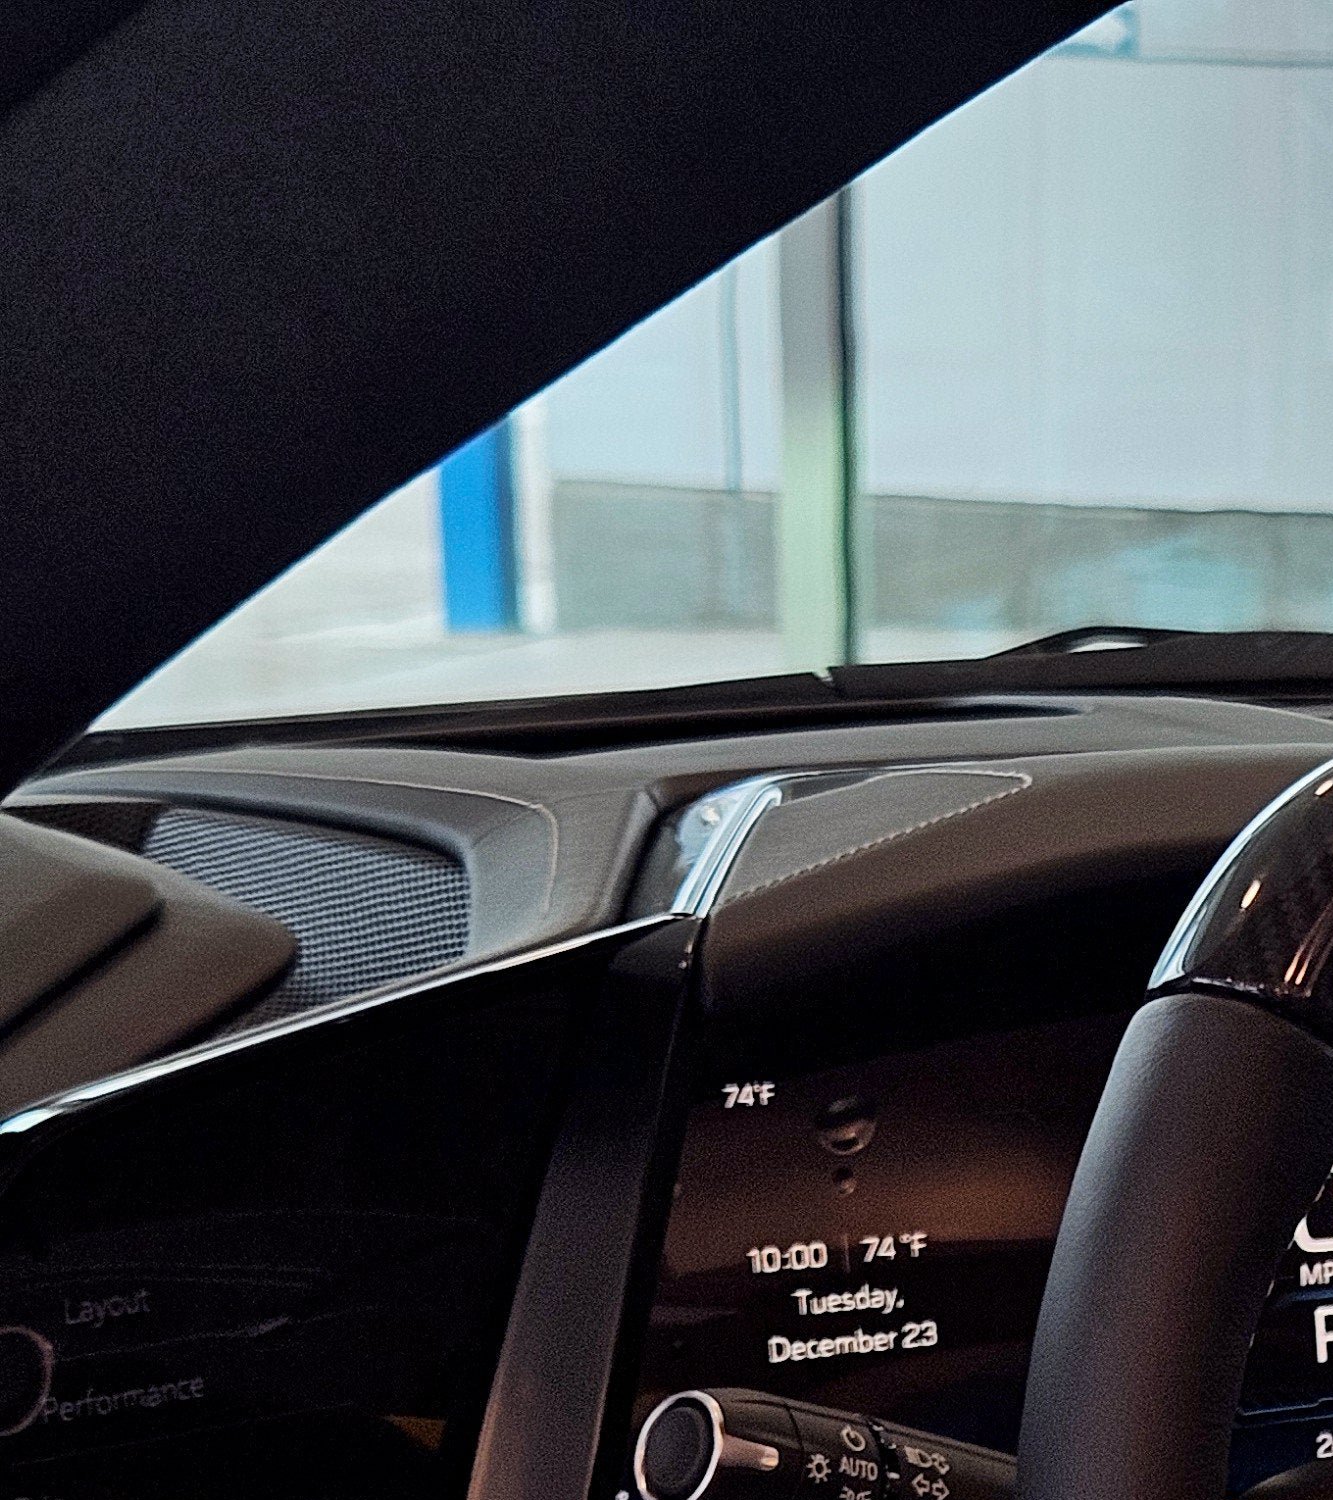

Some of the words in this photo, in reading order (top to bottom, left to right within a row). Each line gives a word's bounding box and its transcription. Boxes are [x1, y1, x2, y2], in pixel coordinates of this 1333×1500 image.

[746, 1241, 828, 1273] 10:00
[63, 1288, 152, 1326] Layout
[767, 1329, 899, 1364] December
[900, 1319, 939, 1348] 23
[40, 1374, 207, 1424] Performance
[838, 1456, 879, 1481] AUTO
